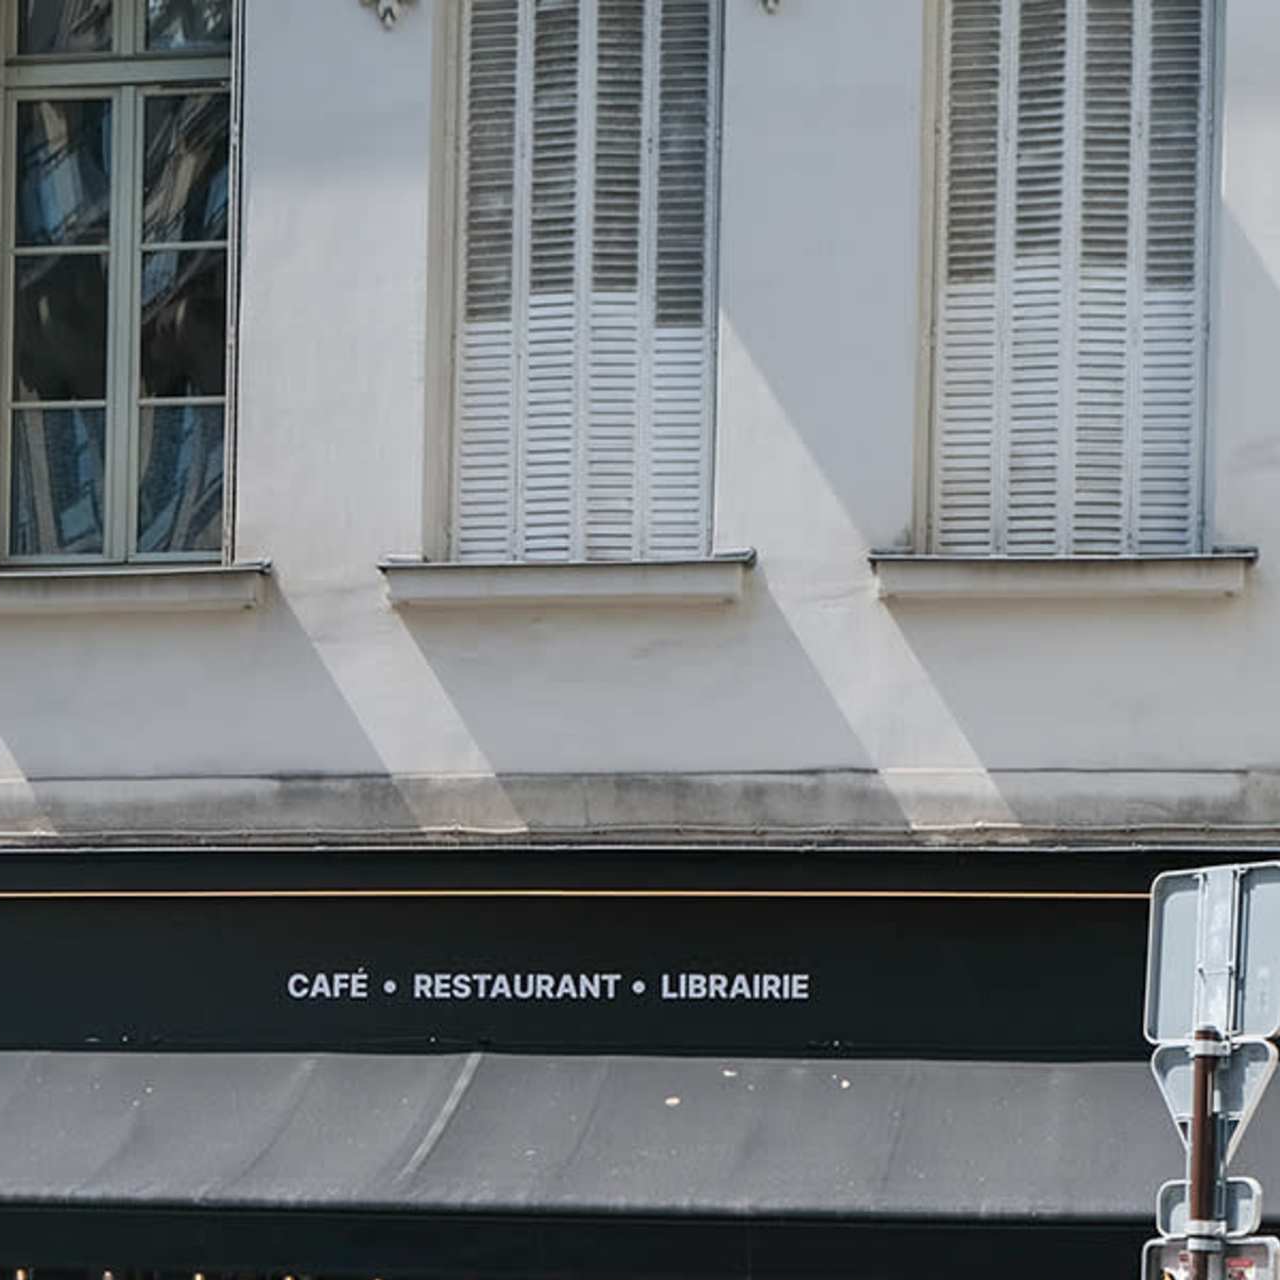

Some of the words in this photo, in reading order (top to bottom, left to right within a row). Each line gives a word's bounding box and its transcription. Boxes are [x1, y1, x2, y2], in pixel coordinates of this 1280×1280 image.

[287, 968, 369, 998] CAFÉ
[414, 974, 621, 998] RESTAURANT
[662, 974, 810, 999] LIBRAIRIE
